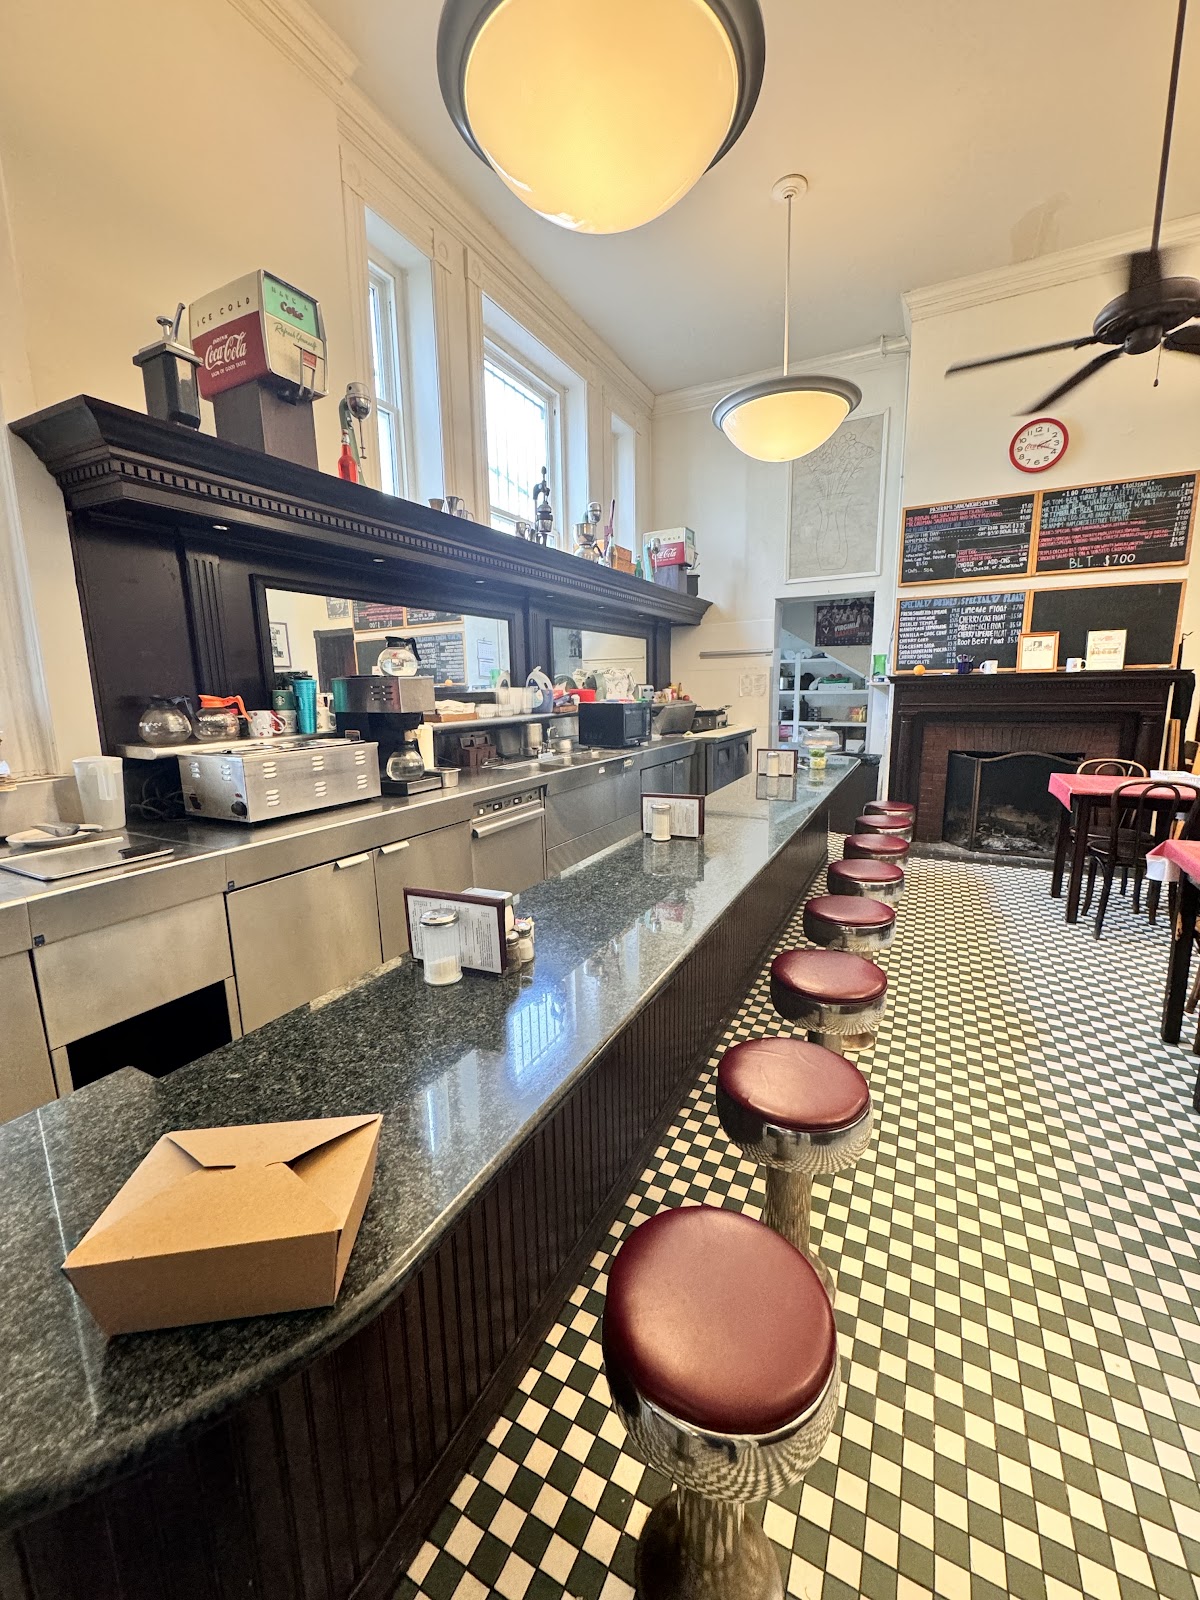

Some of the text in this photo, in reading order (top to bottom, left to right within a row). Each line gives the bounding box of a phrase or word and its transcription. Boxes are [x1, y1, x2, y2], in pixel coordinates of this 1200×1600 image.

[197, 297, 250, 327] ICE COLD
[280, 301, 303, 320] Coke
[205, 332, 247, 370] Coca-Cola
[1066, 496, 1079, 504] REAL
[1119, 486, 1145, 496] LETTUCE
[1107, 495, 1126, 504] BREAST
[1137, 491, 1166, 499] CRANBERRY
[1168, 489, 1184, 498] SAUCE
[1114, 501, 1132, 510] BREAST
[901, 598, 957, 609] SPECIALTY DRINKS
[961, 594, 1000, 604] SPECIALTY
[961, 606, 986, 614] Limeade
[959, 615, 979, 624] CHERRY
[834, 622, 860, 632] VIRGINIA
[991, 622, 1006, 630] FLOAT
